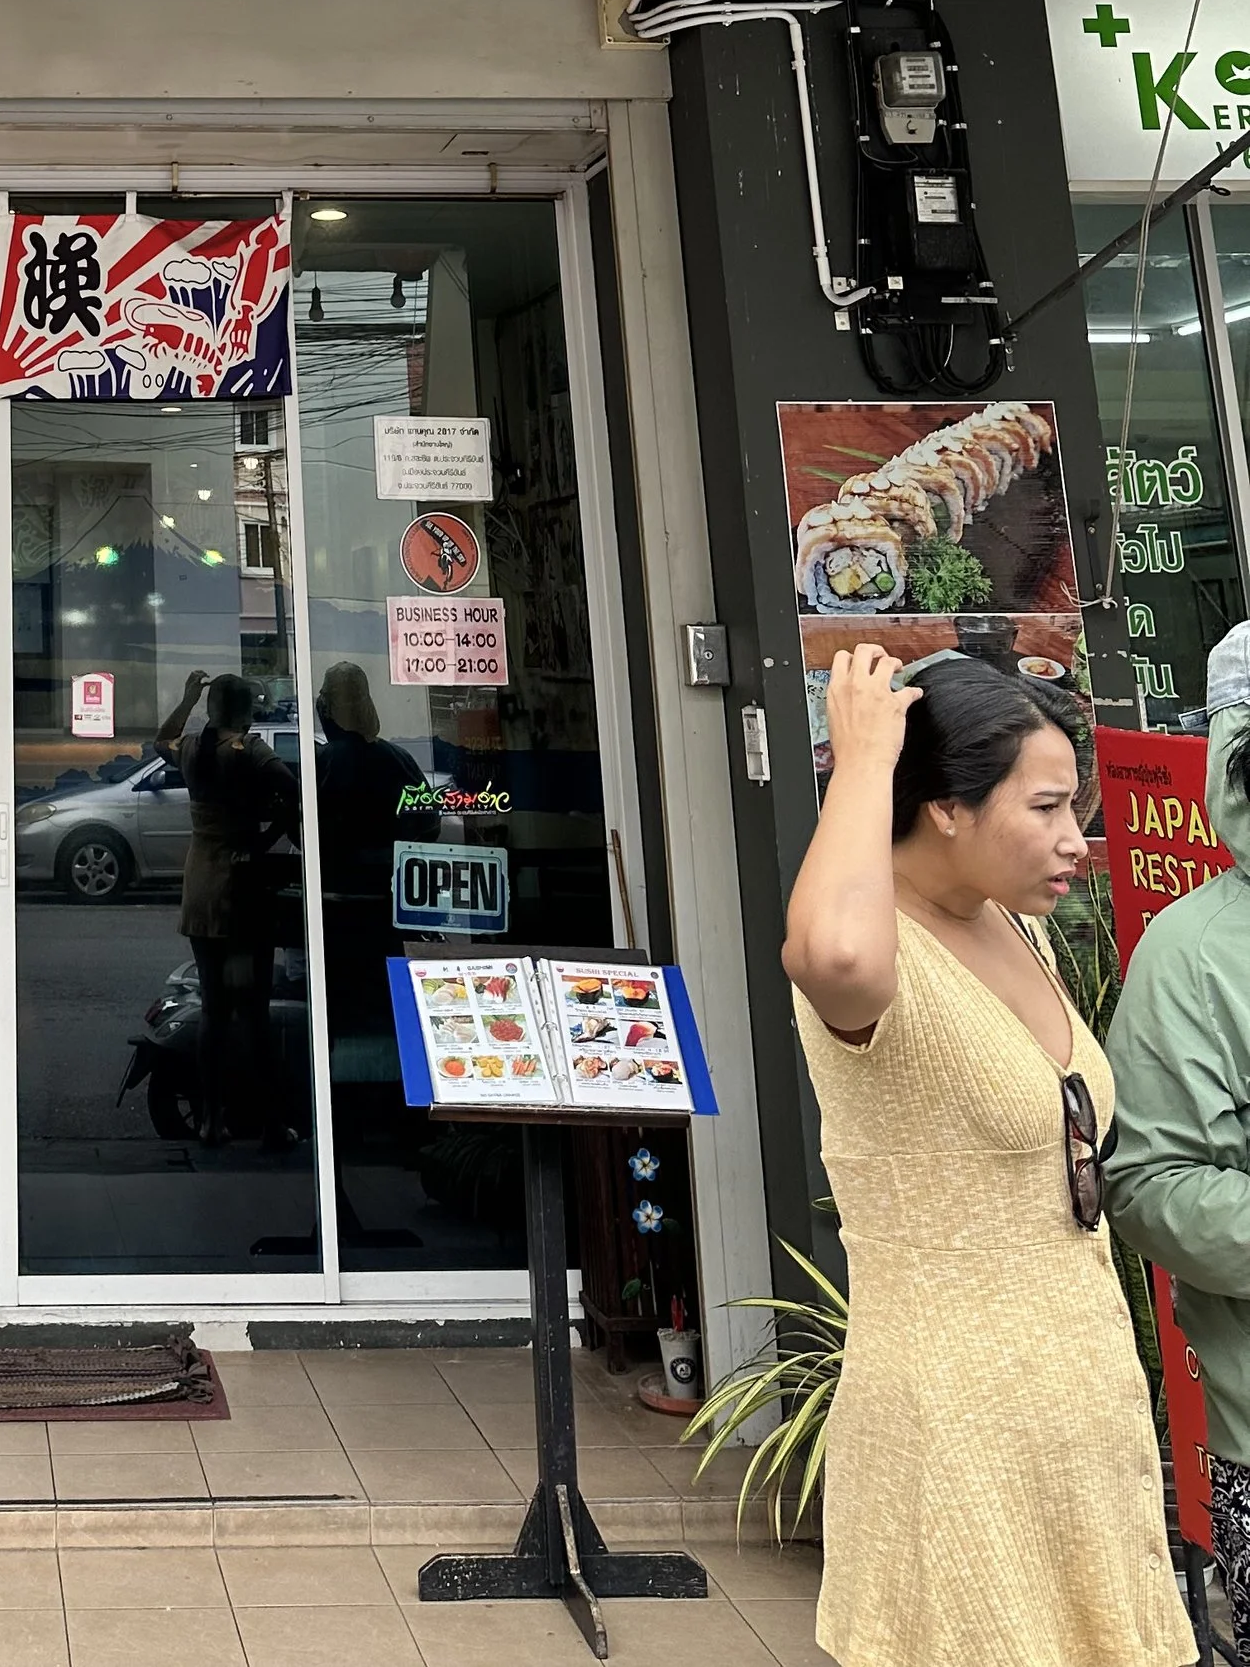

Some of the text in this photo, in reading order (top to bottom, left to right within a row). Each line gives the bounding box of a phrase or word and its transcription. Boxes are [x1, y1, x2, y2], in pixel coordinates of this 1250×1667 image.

[396, 607, 498, 623] BUSINESS HOUR
[404, 857, 498, 911] OPEN
[602, 968, 639, 977] SPECIAL
